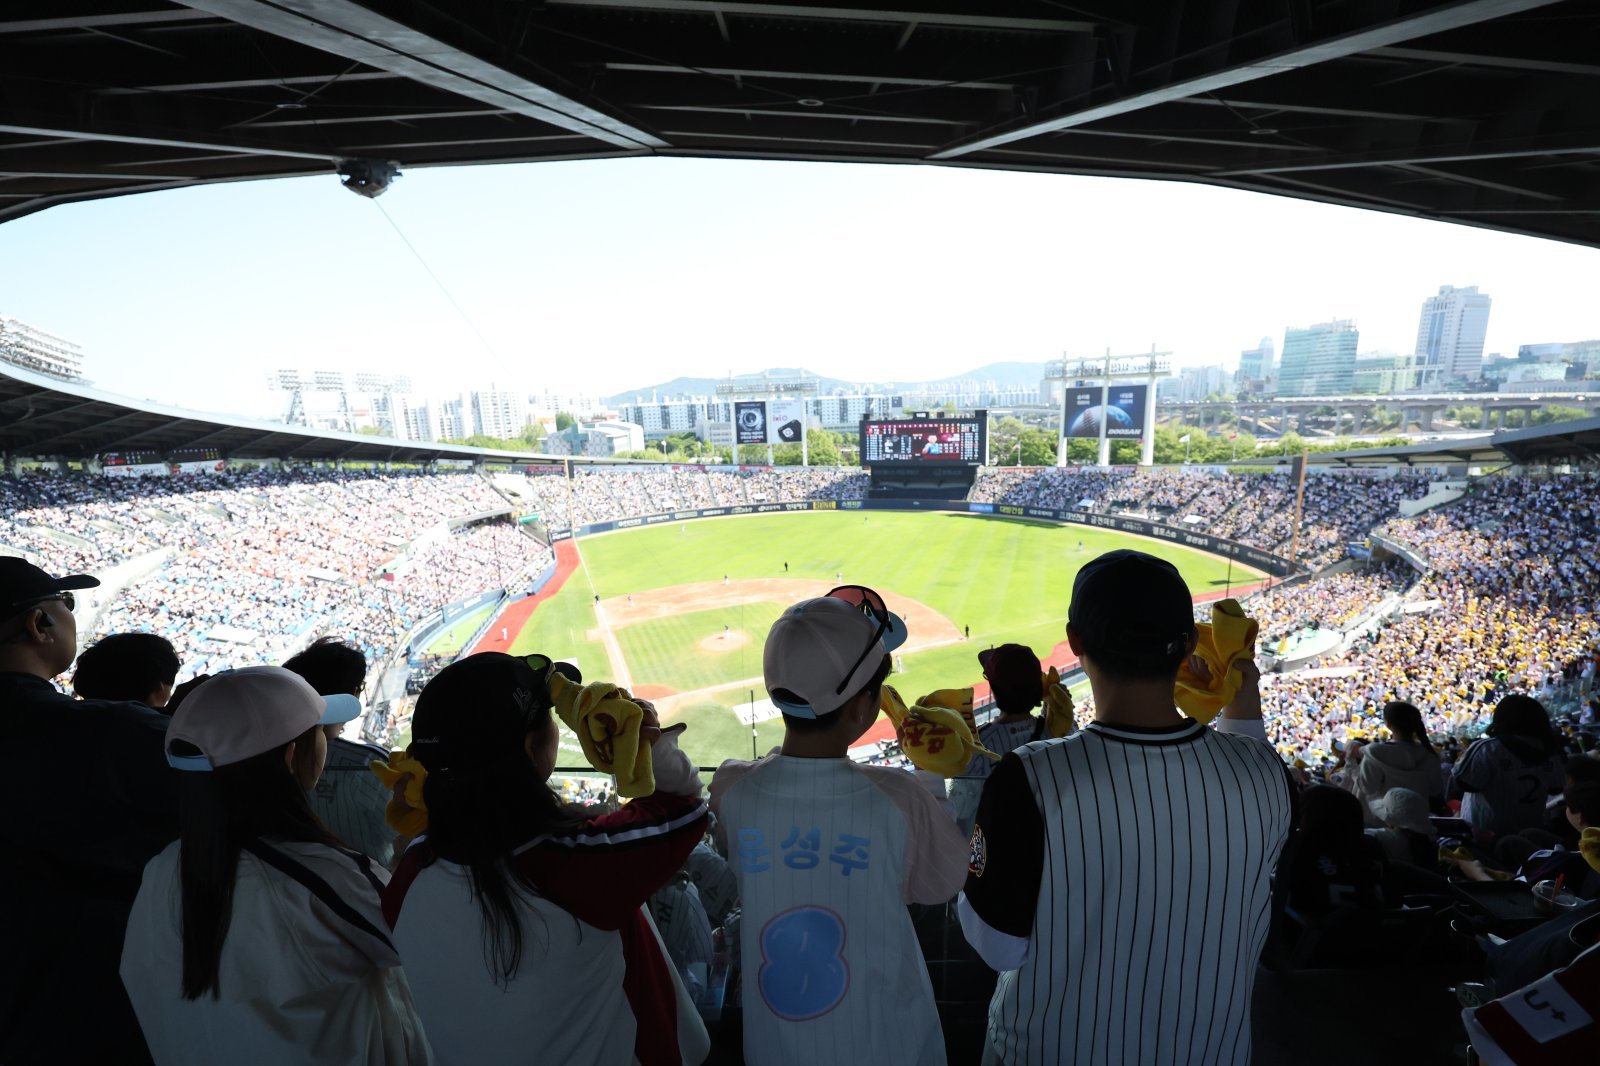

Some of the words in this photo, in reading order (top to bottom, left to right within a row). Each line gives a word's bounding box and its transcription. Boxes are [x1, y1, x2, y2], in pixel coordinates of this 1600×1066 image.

[1518, 774, 1541, 804] 2
[737, 825, 871, 877] 문성주
[758, 904, 850, 1022] 8
